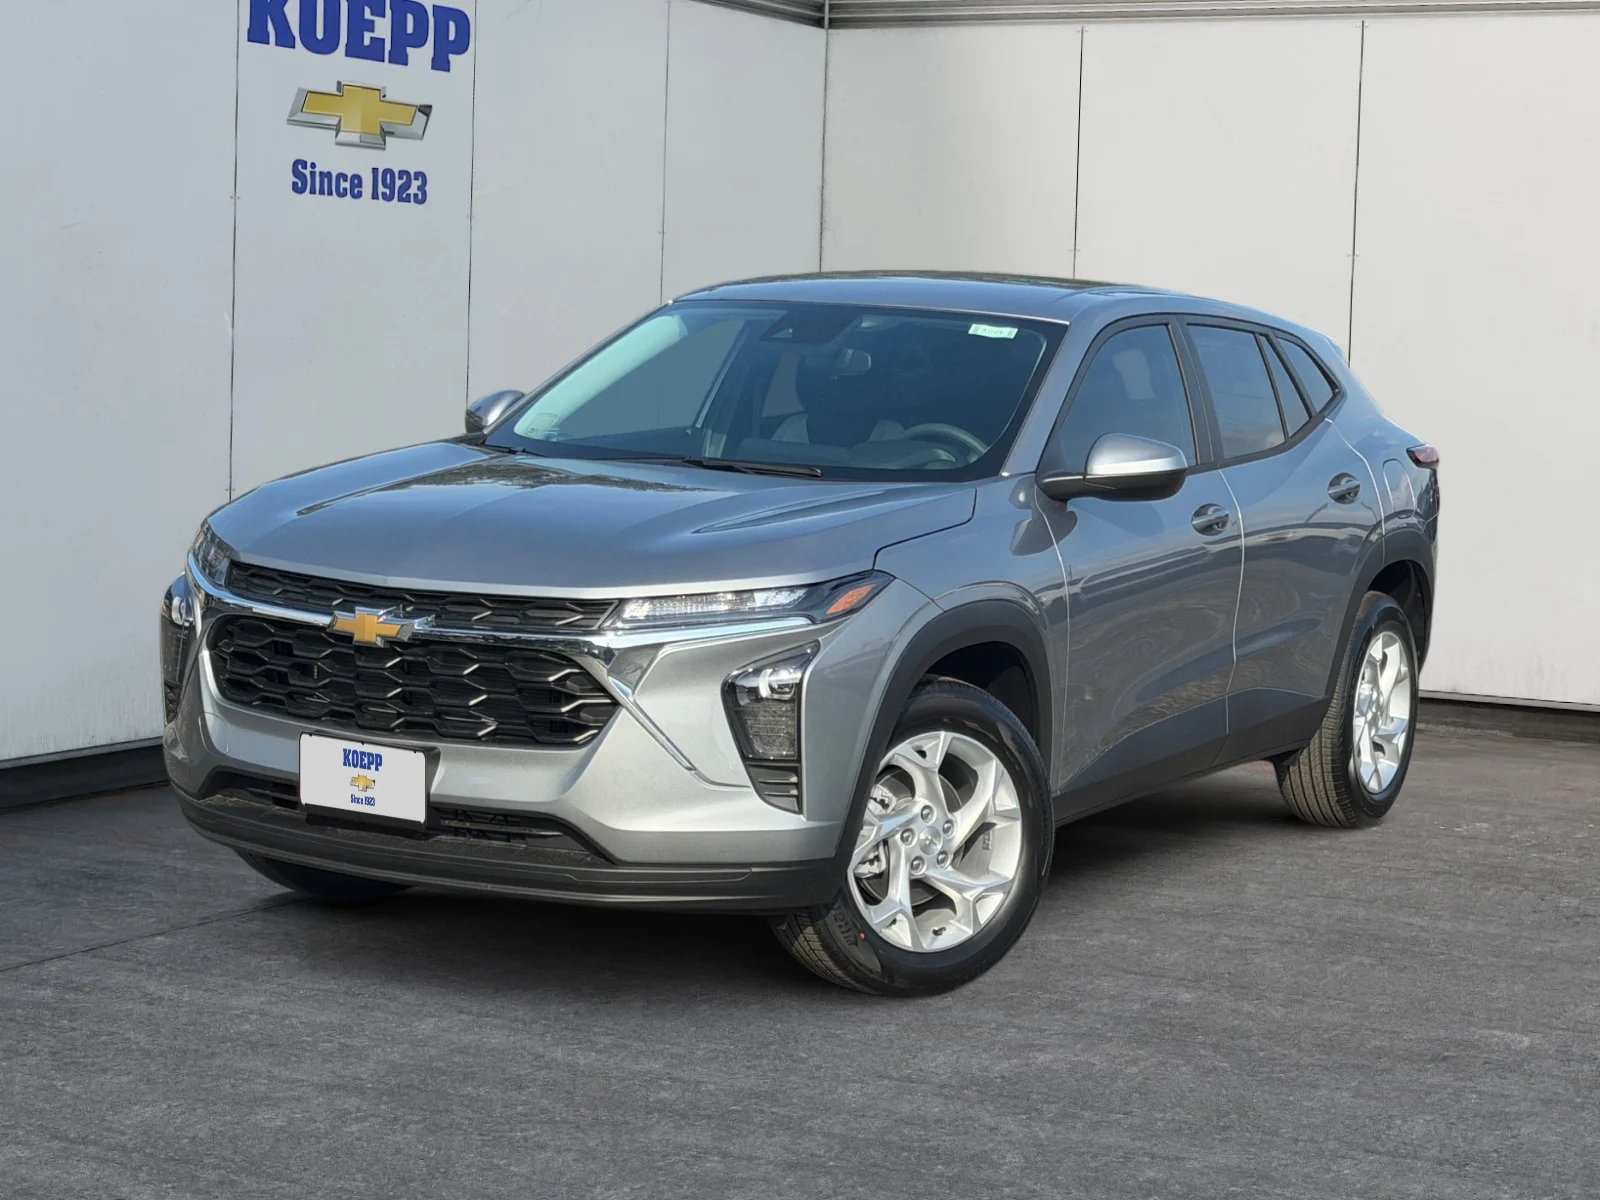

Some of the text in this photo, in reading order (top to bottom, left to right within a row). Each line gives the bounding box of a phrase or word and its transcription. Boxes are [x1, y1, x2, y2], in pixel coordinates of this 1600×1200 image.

[247, 0, 471, 73] KOEPP
[291, 158, 428, 205] Since 1923
[342, 747, 383, 771] KOEPP
[350, 793, 376, 807] Since 1923
